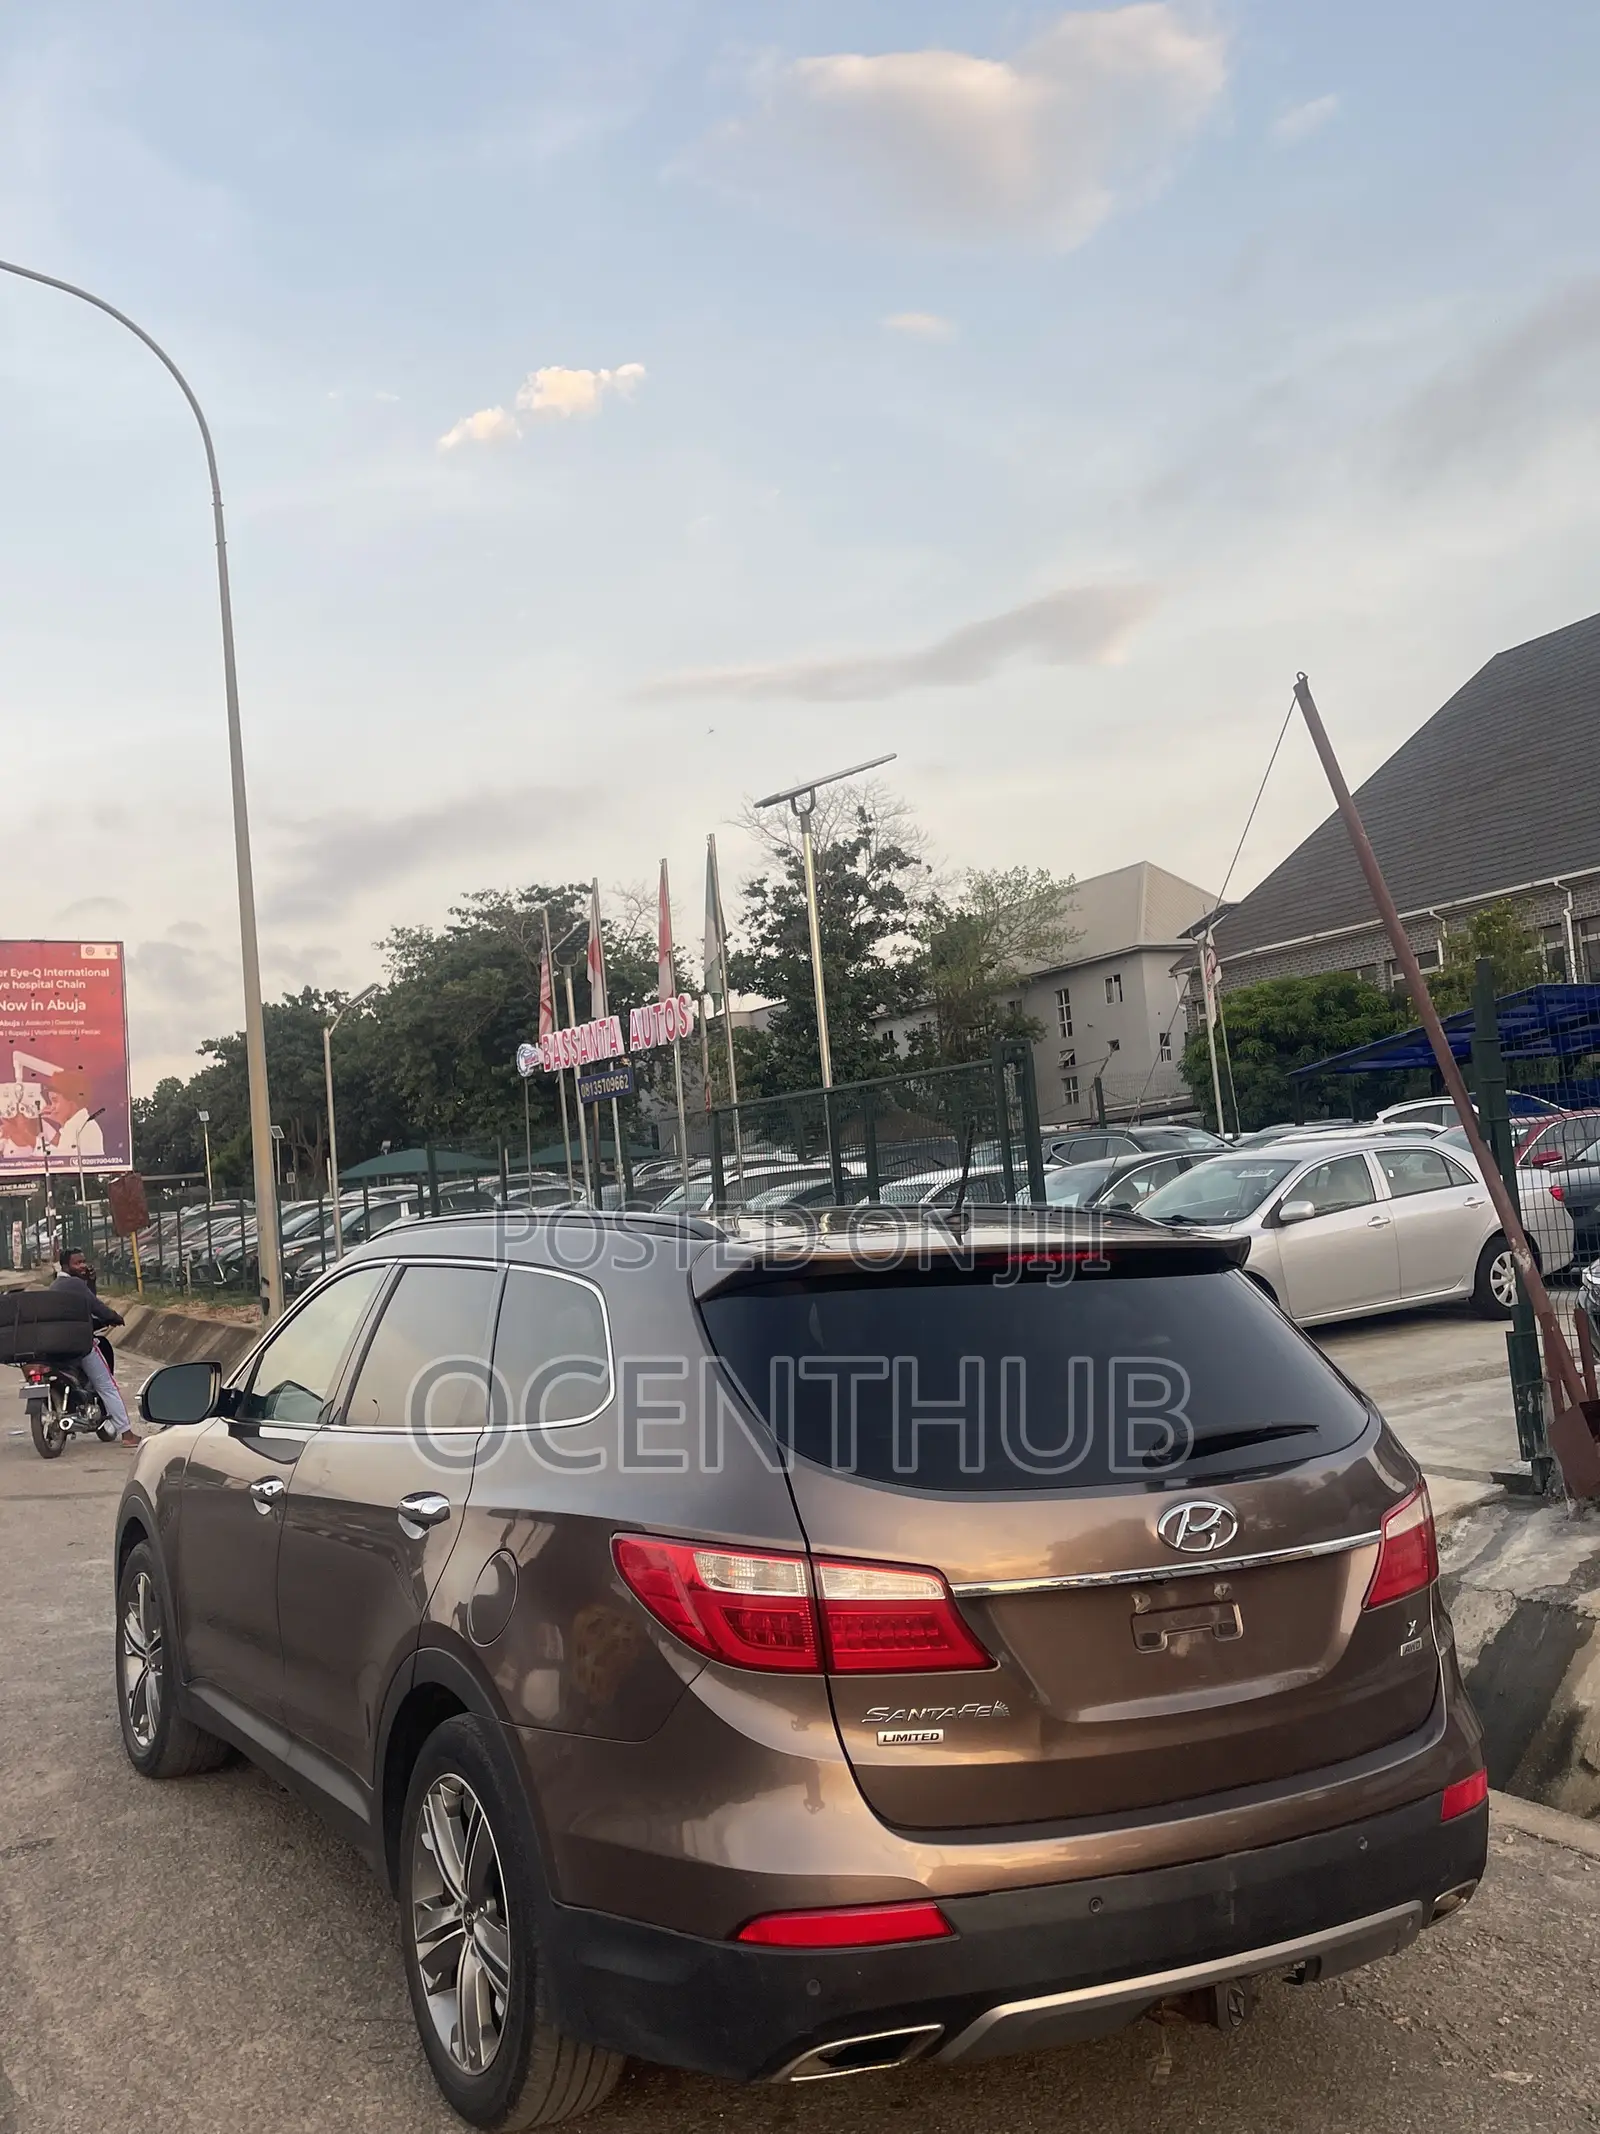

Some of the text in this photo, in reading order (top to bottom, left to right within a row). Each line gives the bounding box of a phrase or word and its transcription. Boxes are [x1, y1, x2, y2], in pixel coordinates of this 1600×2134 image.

[10, 968, 42, 979] Eye-Q
[44, 968, 110, 977] International
[12, 980, 54, 991] hospital
[56, 980, 86, 989] Chain
[0, 998, 86, 1013] Now in Abuja
[541, 993, 692, 1073] BASSANTA AUTOS
[882, 1732, 940, 1743] LIMITED
